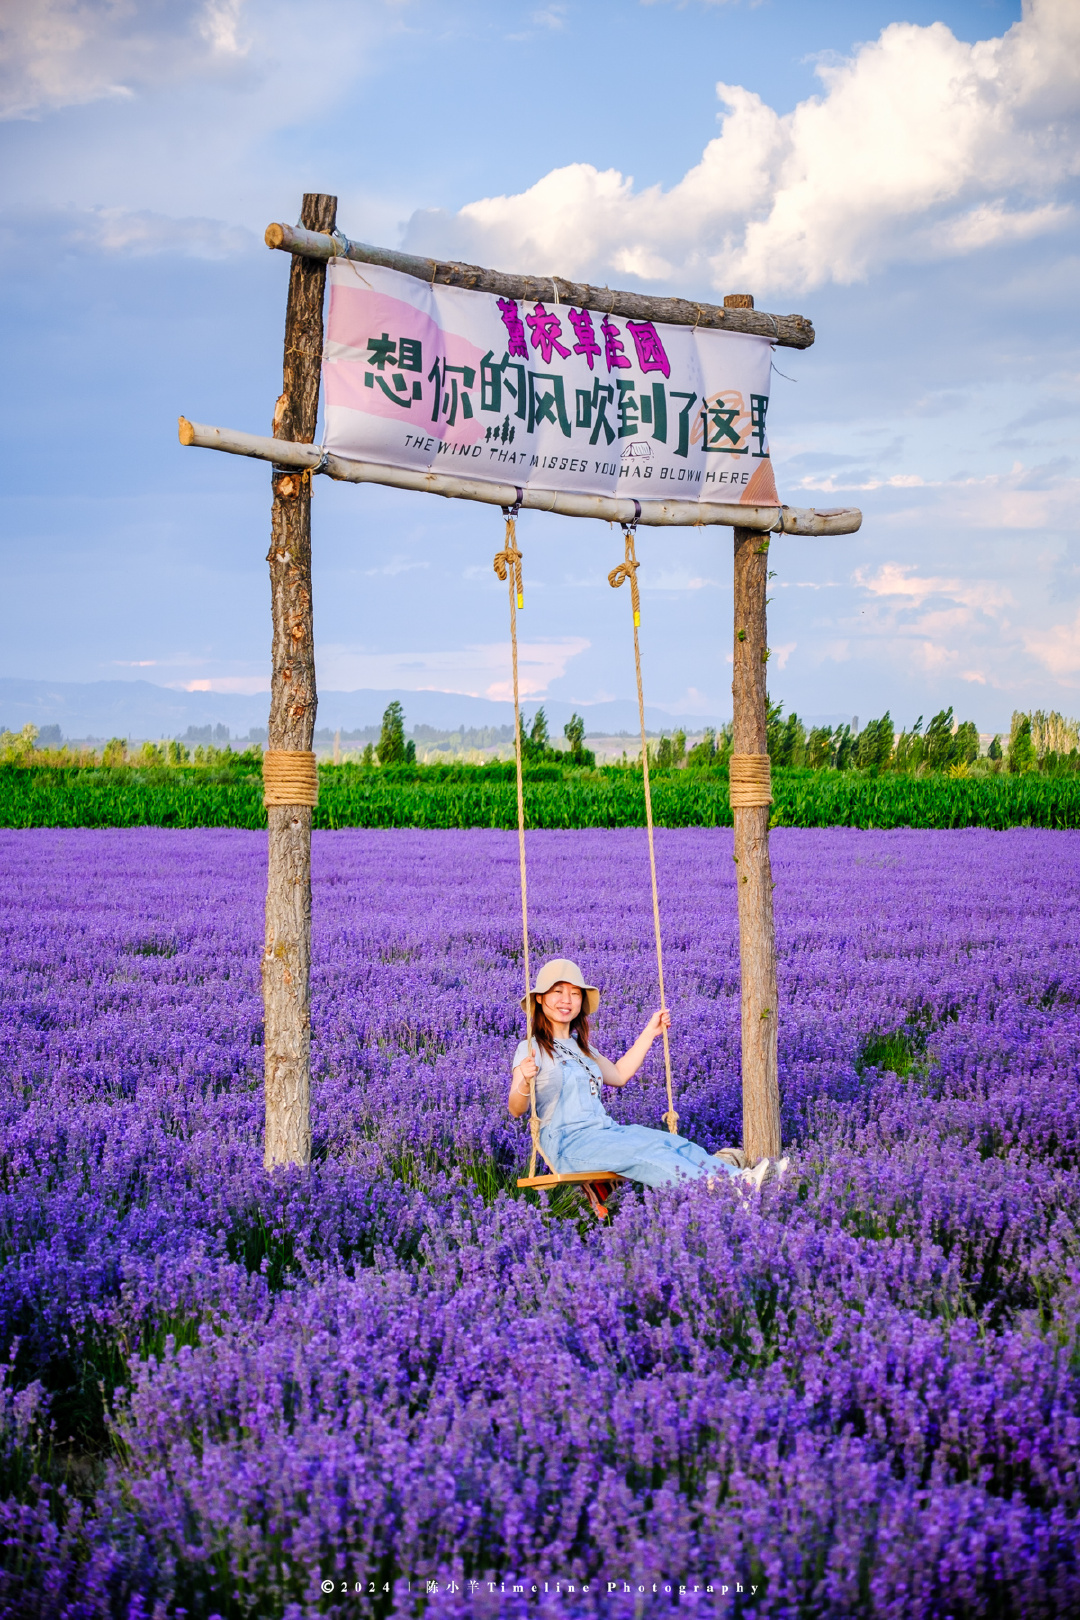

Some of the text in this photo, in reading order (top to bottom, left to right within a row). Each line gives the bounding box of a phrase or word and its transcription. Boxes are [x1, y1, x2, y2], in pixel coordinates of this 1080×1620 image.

[364, 333, 770, 458] 想你的风吹到了这里
[404, 435, 749, 485] THE WIND THAT MISSES YOU HAS BLOWN HERE
